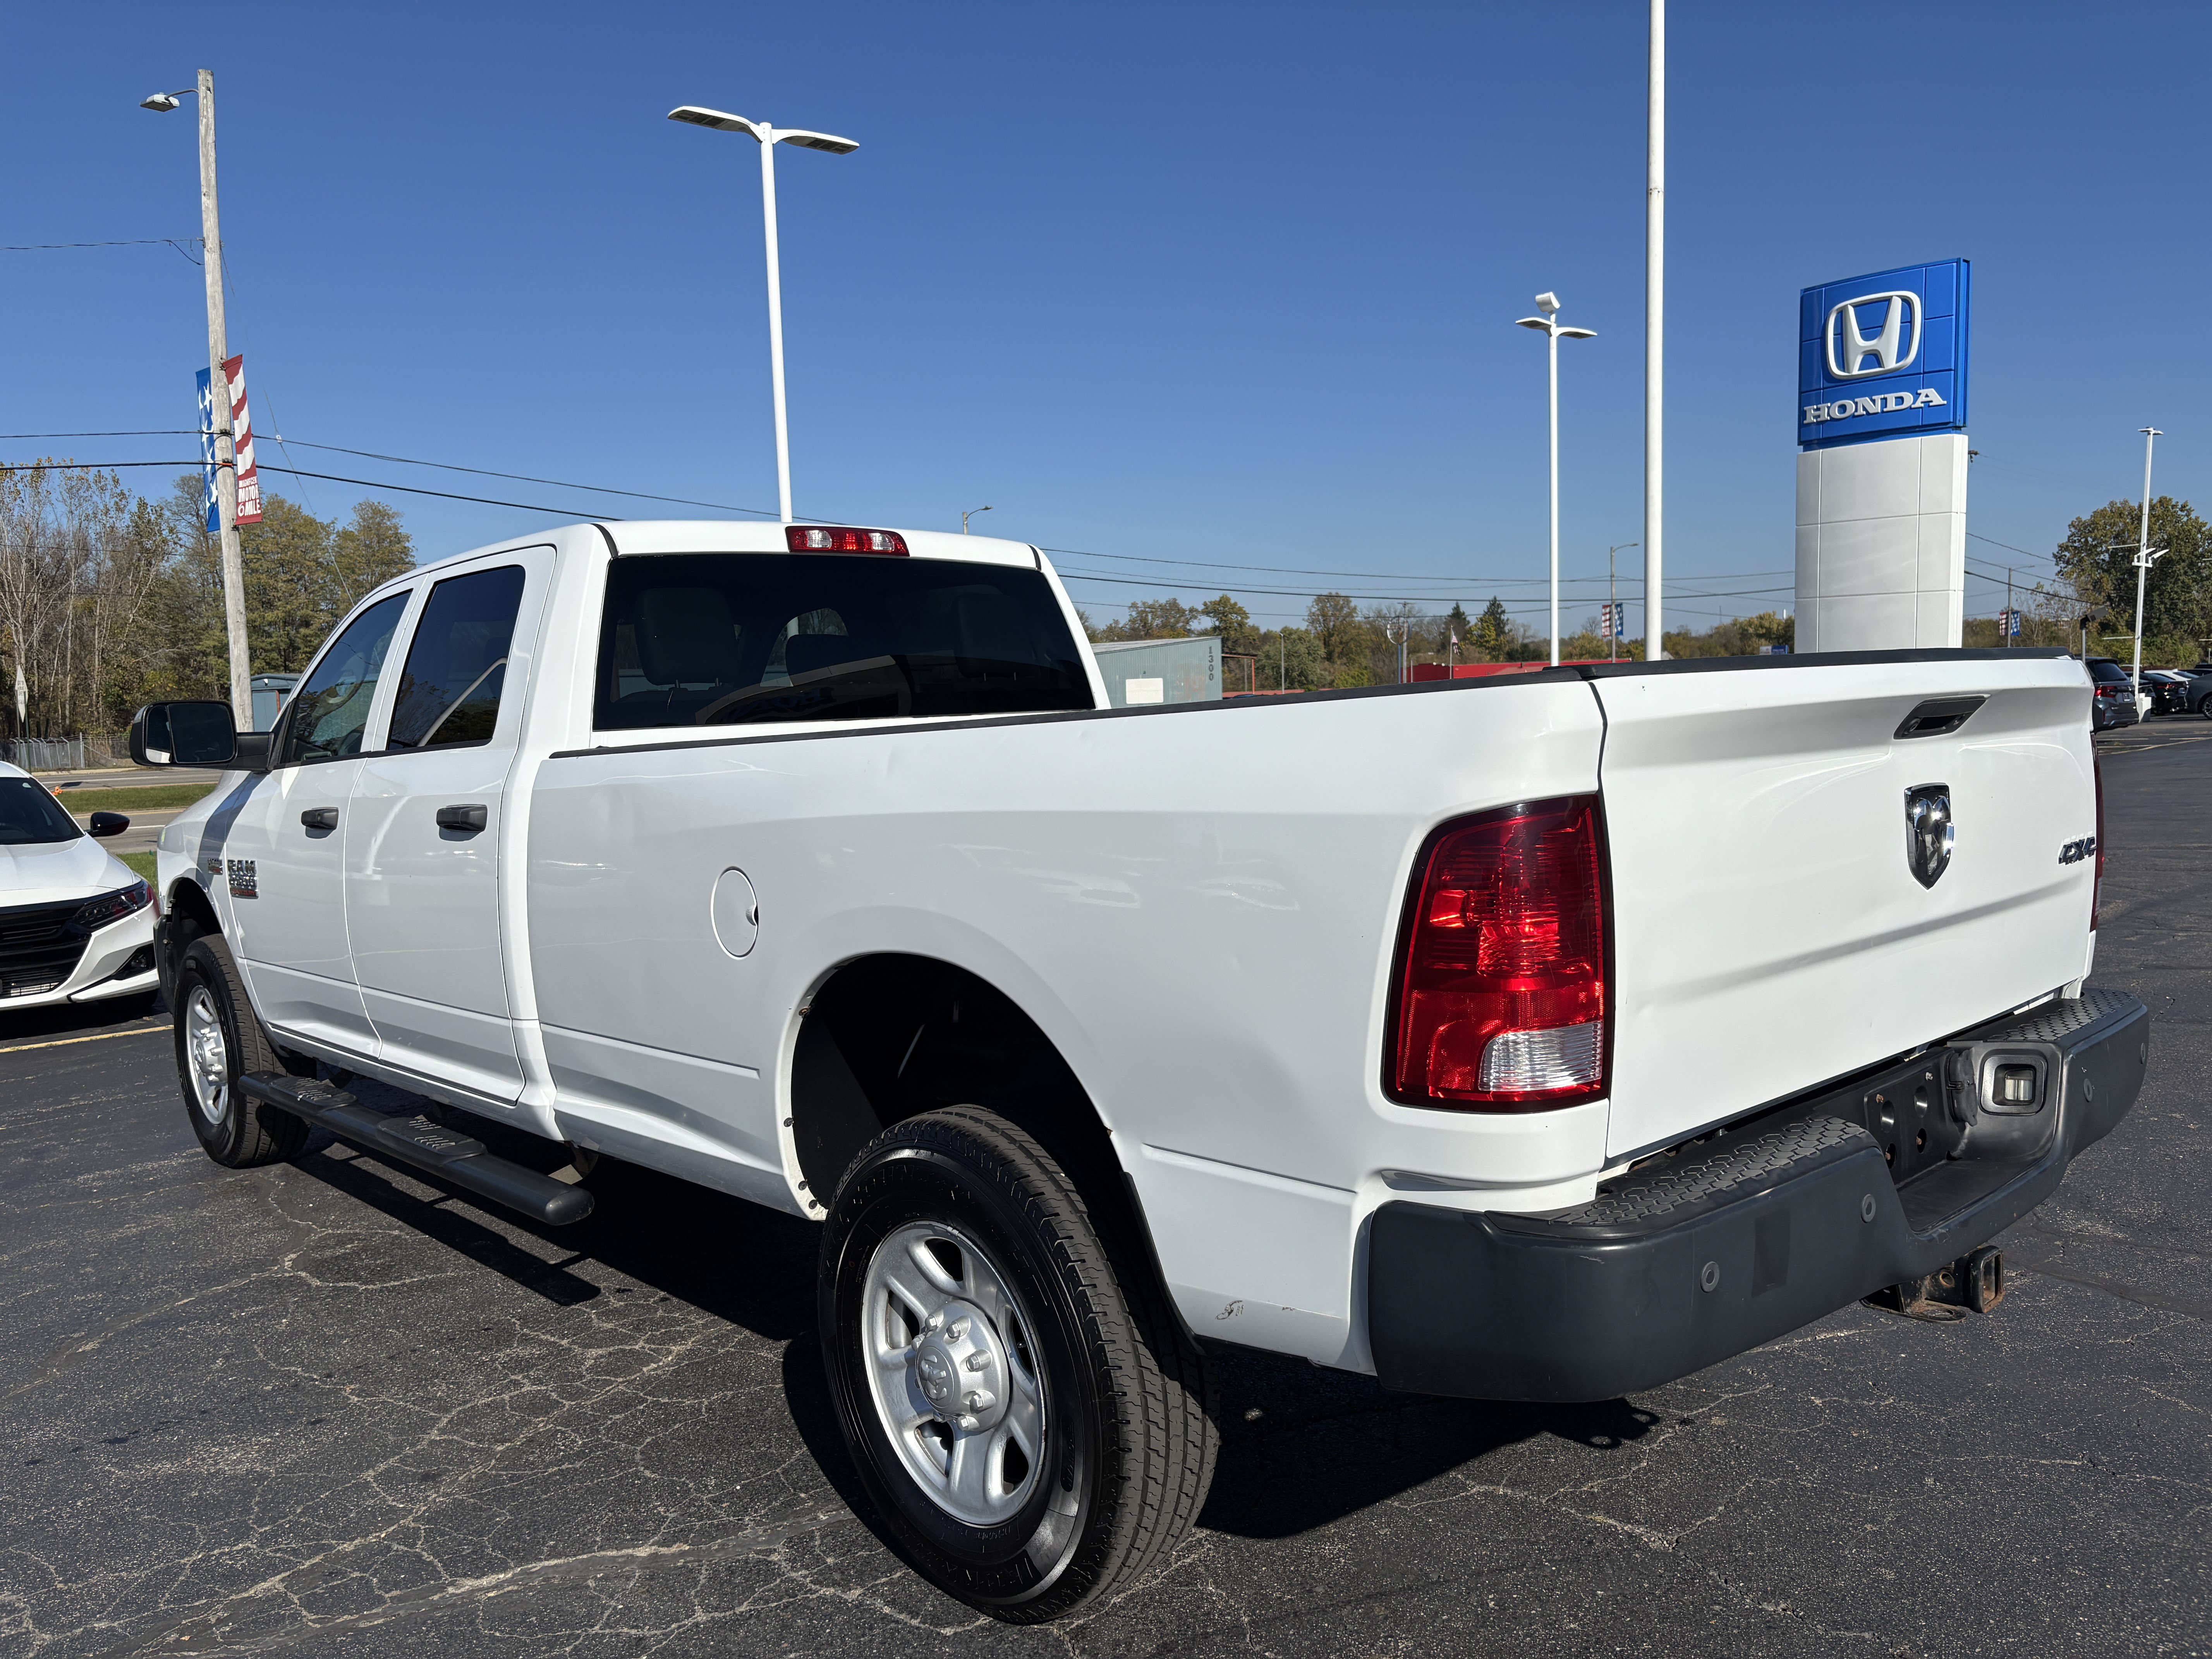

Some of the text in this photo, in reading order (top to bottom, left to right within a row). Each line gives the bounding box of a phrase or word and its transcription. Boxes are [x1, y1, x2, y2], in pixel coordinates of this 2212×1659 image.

[1803, 388, 1947, 424] HONDA
[238, 484, 259, 503] MOTOR
[238, 499, 261, 517] 6 MILE
[227, 859, 258, 874] RAM
